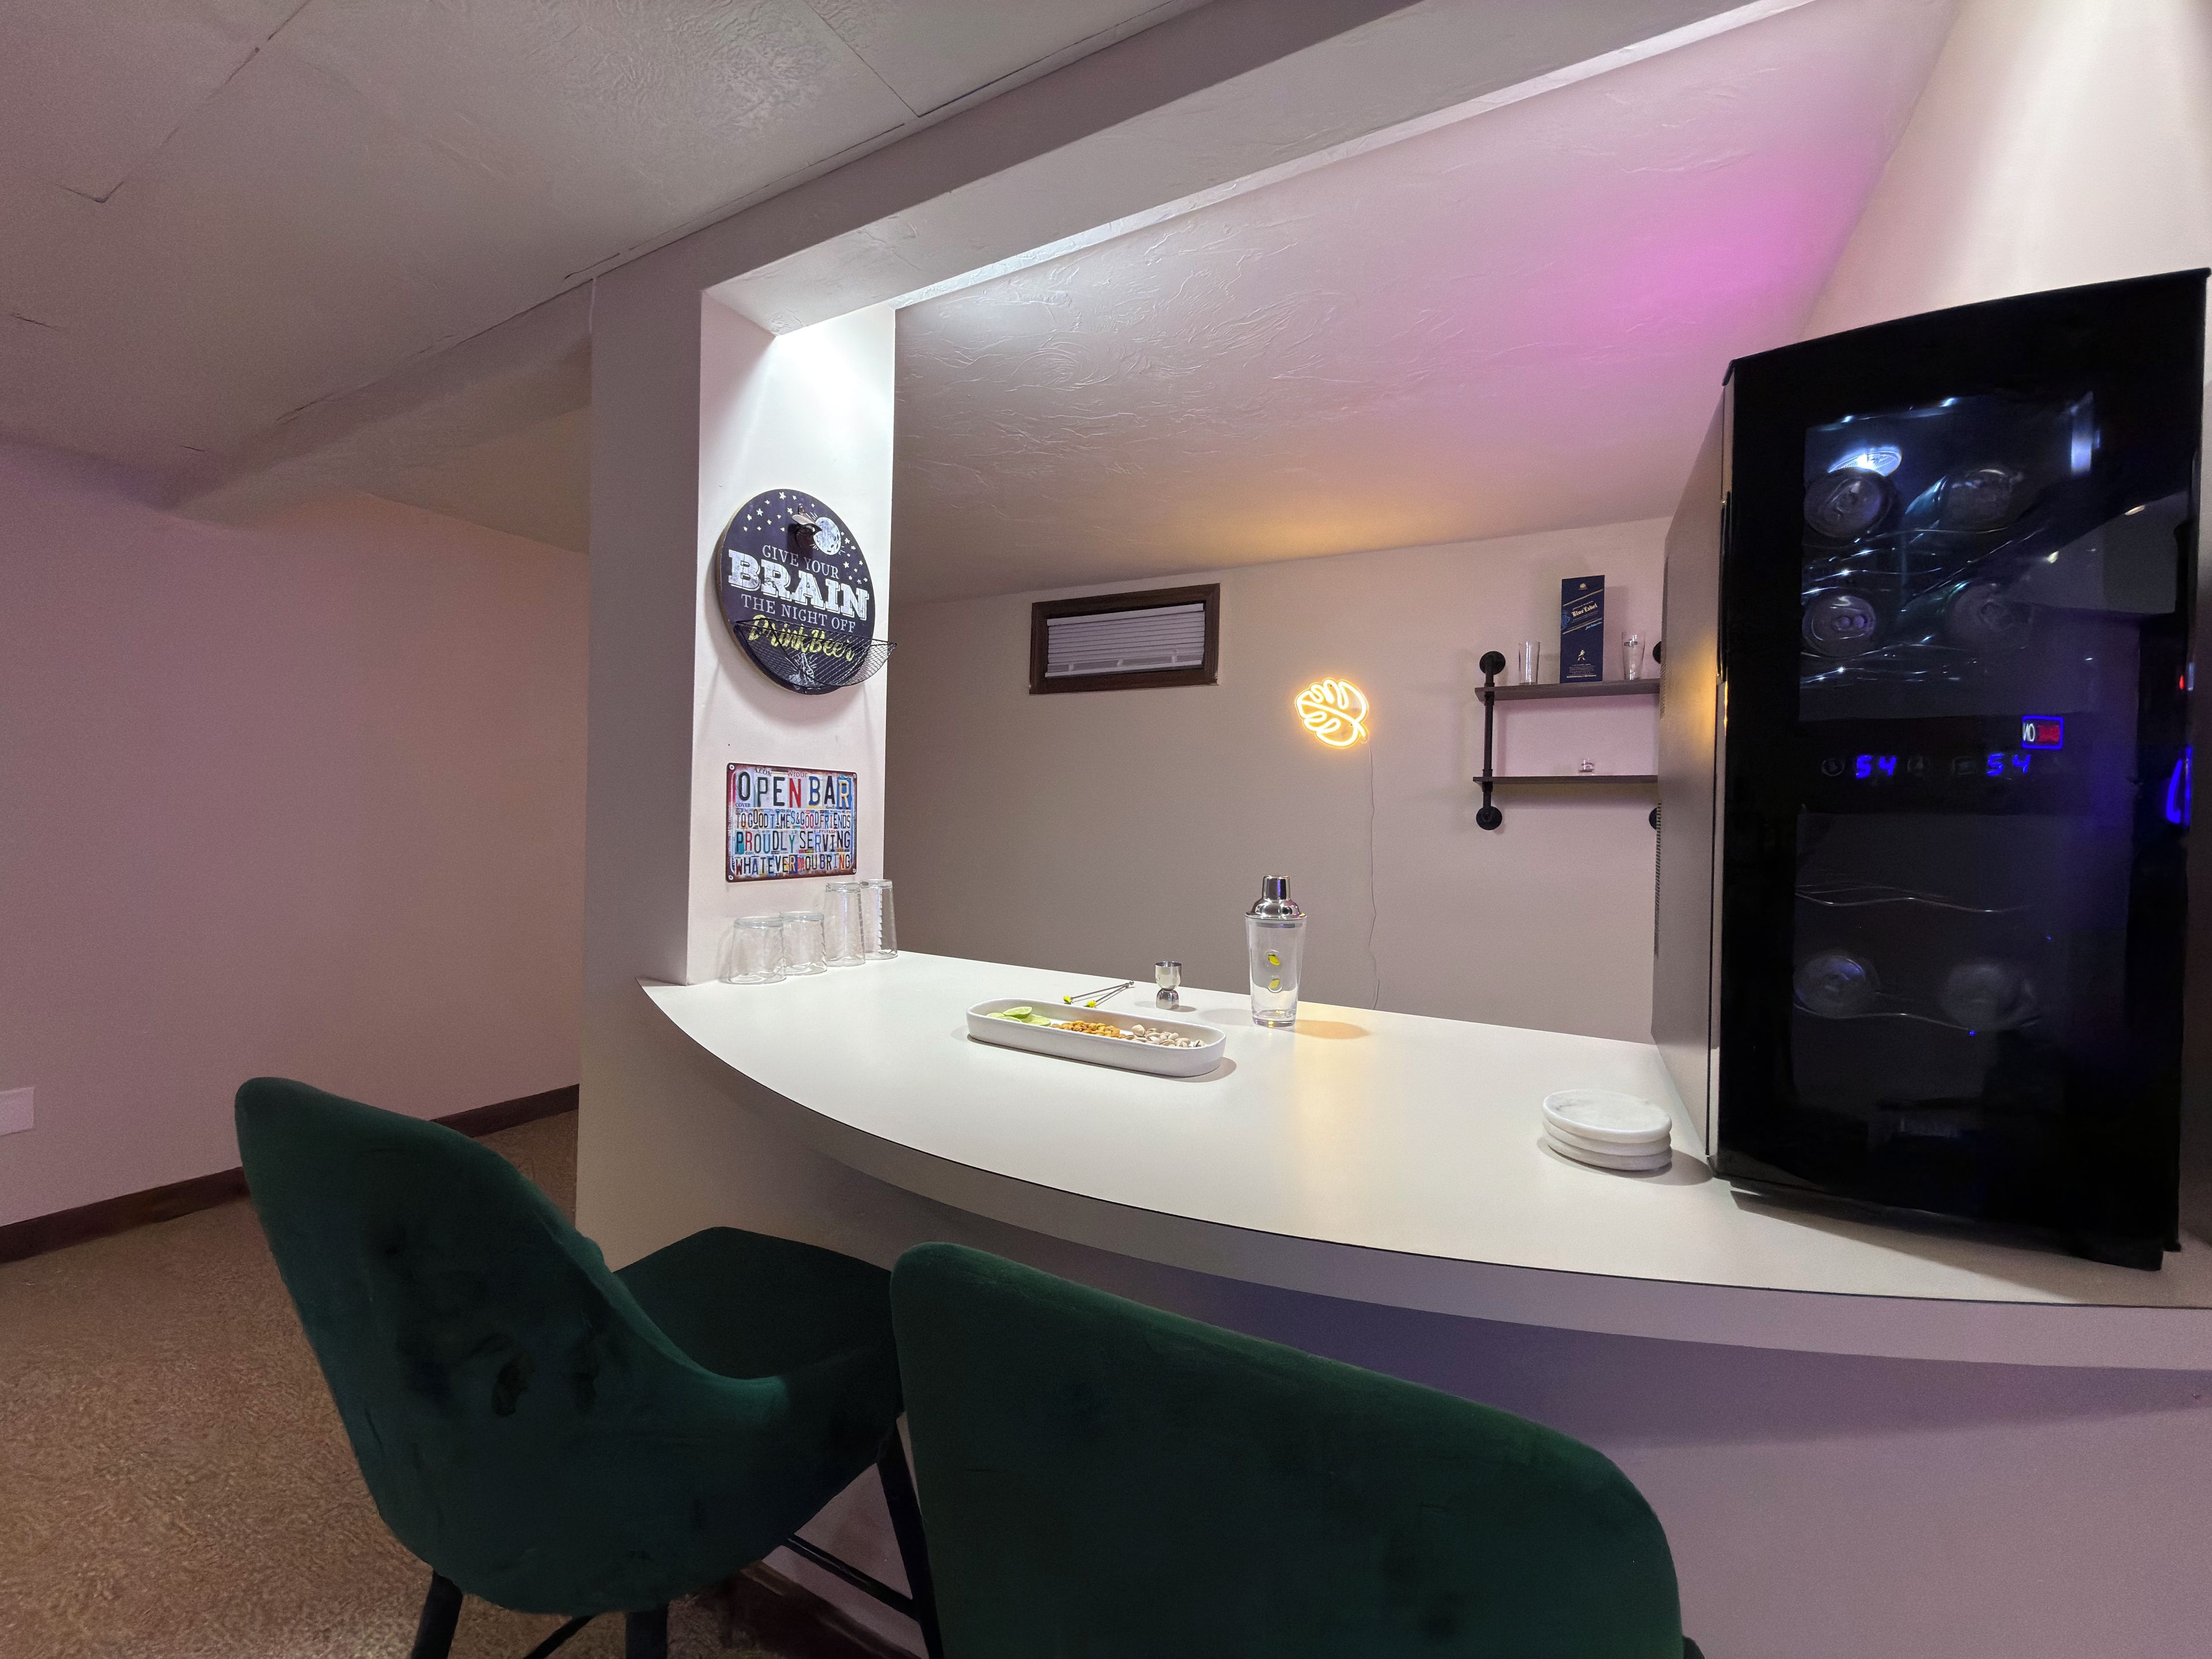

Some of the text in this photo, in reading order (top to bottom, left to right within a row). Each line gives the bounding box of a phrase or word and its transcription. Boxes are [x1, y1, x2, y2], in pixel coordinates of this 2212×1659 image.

[762, 544, 839, 579] GIVE YOUR
[728, 549, 870, 621] BRAIN
[741, 593, 856, 633] THE NIGHT OFF
[1584, 603, 1598, 612] Label
[1854, 752, 2031, 779] 54 54
[738, 771, 850, 808] OPEN BAR
[735, 812, 747, 829] TO
[748, 809, 768, 829] GOOD
[820, 812, 851, 830] FRIENDS
[736, 830, 851, 854] PROUDLY SERVING
[735, 855, 796, 876] WHATEVER
[820, 854, 851, 870] BRING
